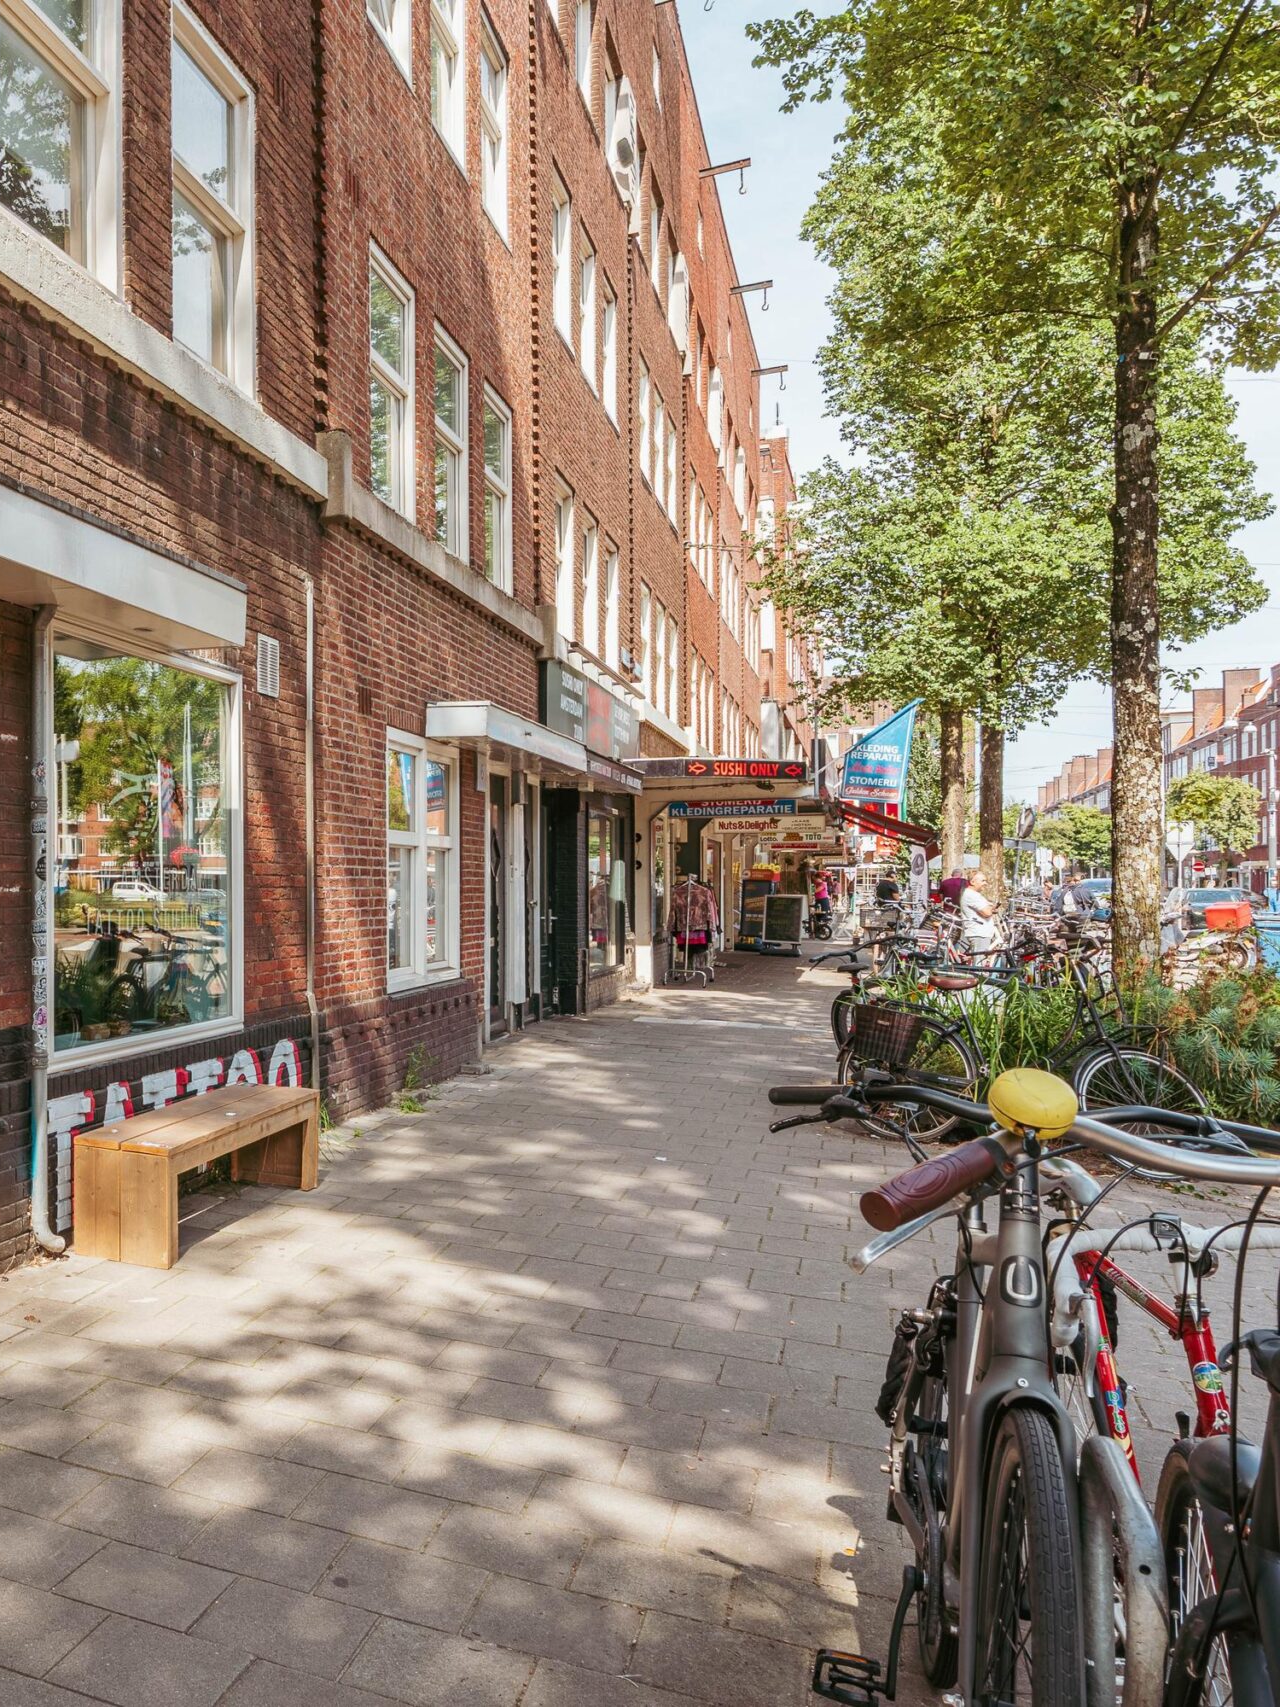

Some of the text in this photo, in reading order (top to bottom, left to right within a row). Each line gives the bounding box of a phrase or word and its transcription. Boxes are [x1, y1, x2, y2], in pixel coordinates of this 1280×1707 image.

[856, 743, 899, 754] KLEDING
[851, 752, 902, 762] REPARATIE
[713, 762, 779, 776] SUSHI ONLY
[849, 776, 898, 787] STOMERIJ
[672, 805, 793, 817] KLEDINGREPARATIE
[718, 820, 779, 831] Nuts&Delights
[122, 866, 212, 892] AMSTERDA
